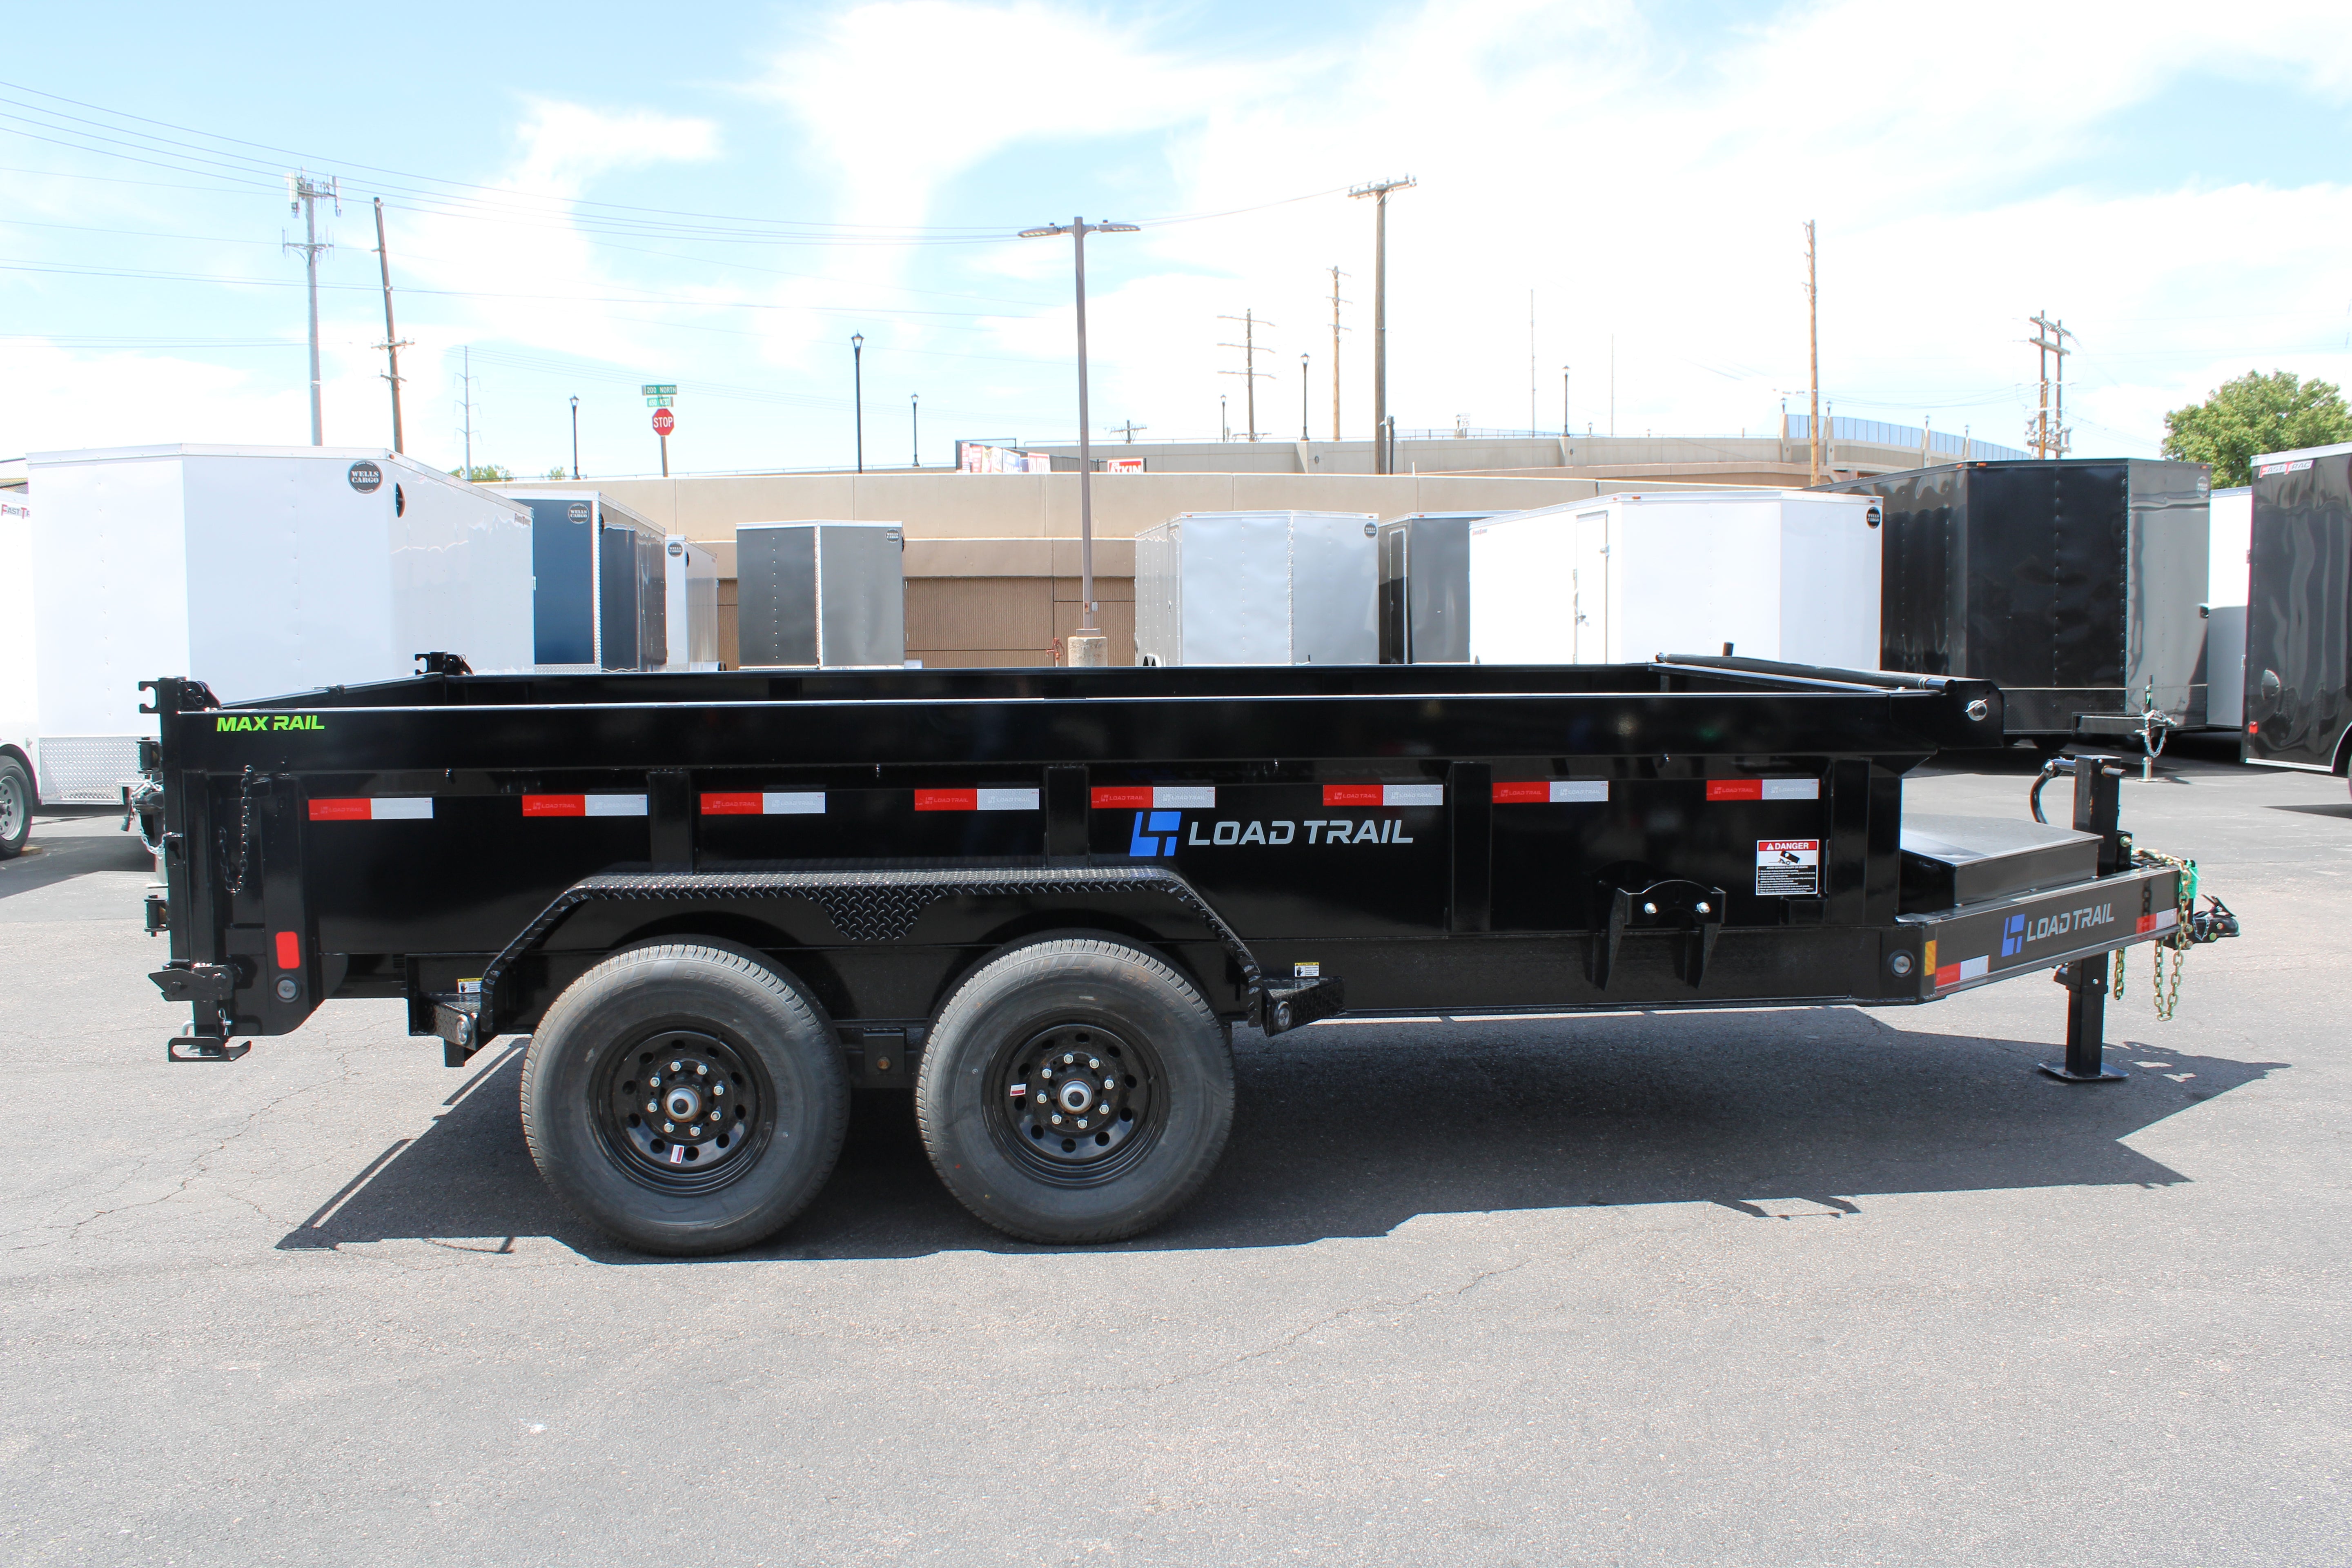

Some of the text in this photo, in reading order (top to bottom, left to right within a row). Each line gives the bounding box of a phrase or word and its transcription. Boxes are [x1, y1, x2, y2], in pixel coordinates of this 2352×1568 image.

[653, 416, 673, 428] STOP
[216, 715, 325, 731] MAX RAIL
[1188, 820, 1413, 845] LOAD TRAIL
[2026, 902, 2114, 942] LOAD TRAIL
